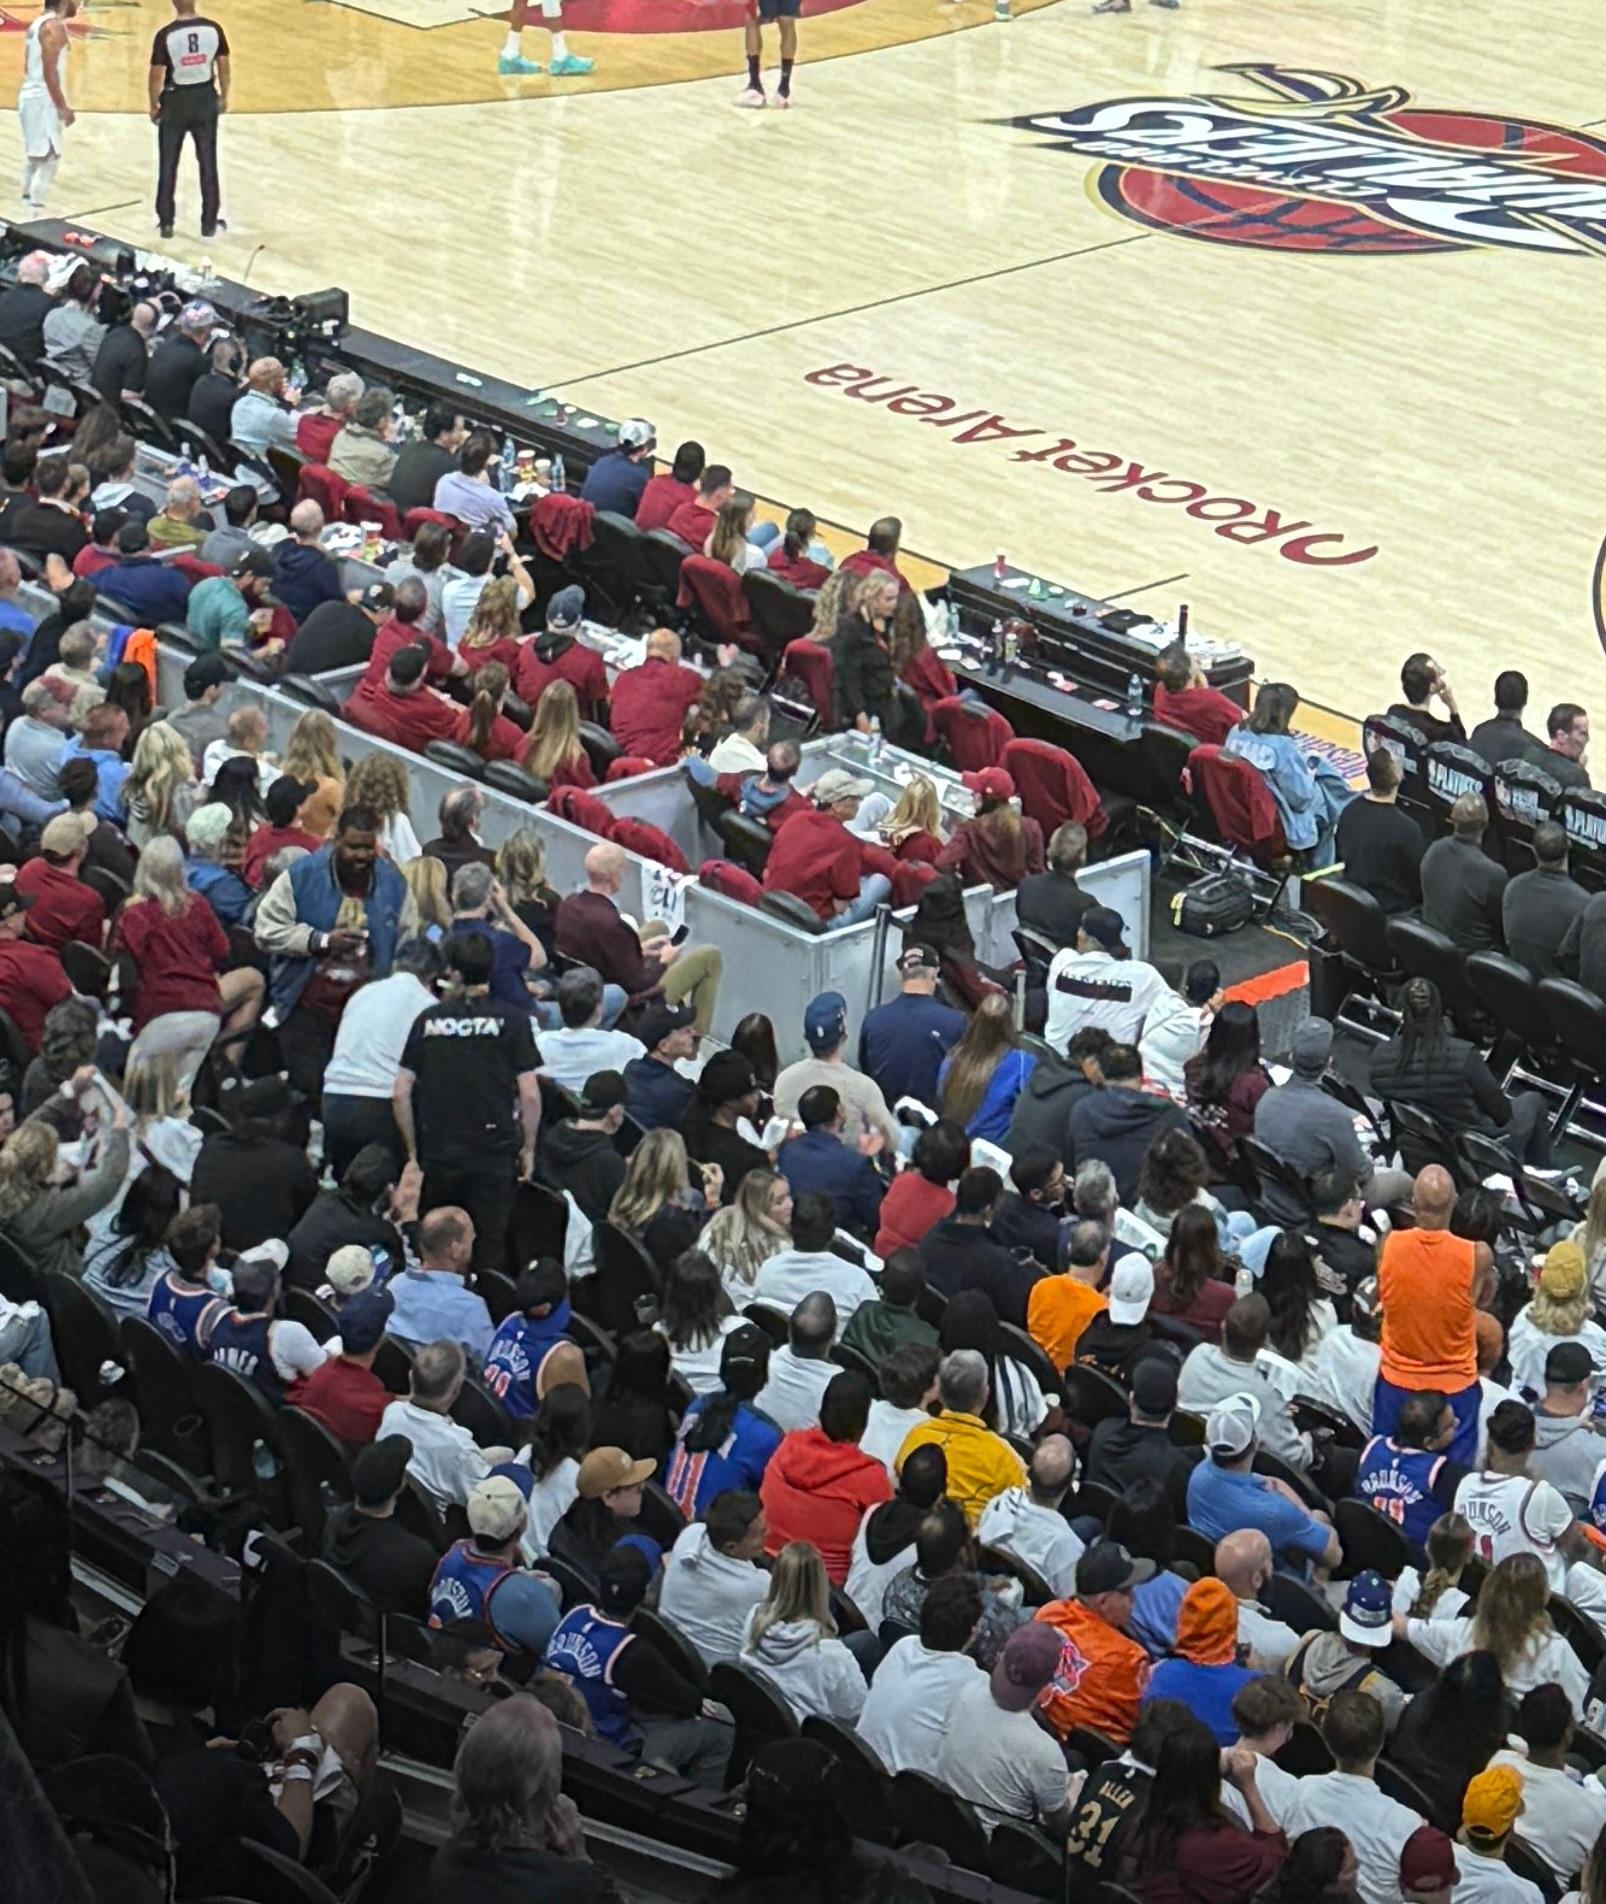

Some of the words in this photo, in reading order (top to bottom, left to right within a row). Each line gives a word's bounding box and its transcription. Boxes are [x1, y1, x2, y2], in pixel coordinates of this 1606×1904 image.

[187, 32, 200, 54] 8
[803, 363, 1046, 444] Arena
[1006, 437, 1314, 546] Rocket
[424, 1017, 499, 1038] NOCTA
[1360, 1469, 1424, 1506] BRUNSON
[1096, 1779, 1136, 1810] ALLEN
[1067, 1800, 1120, 1869] 31
